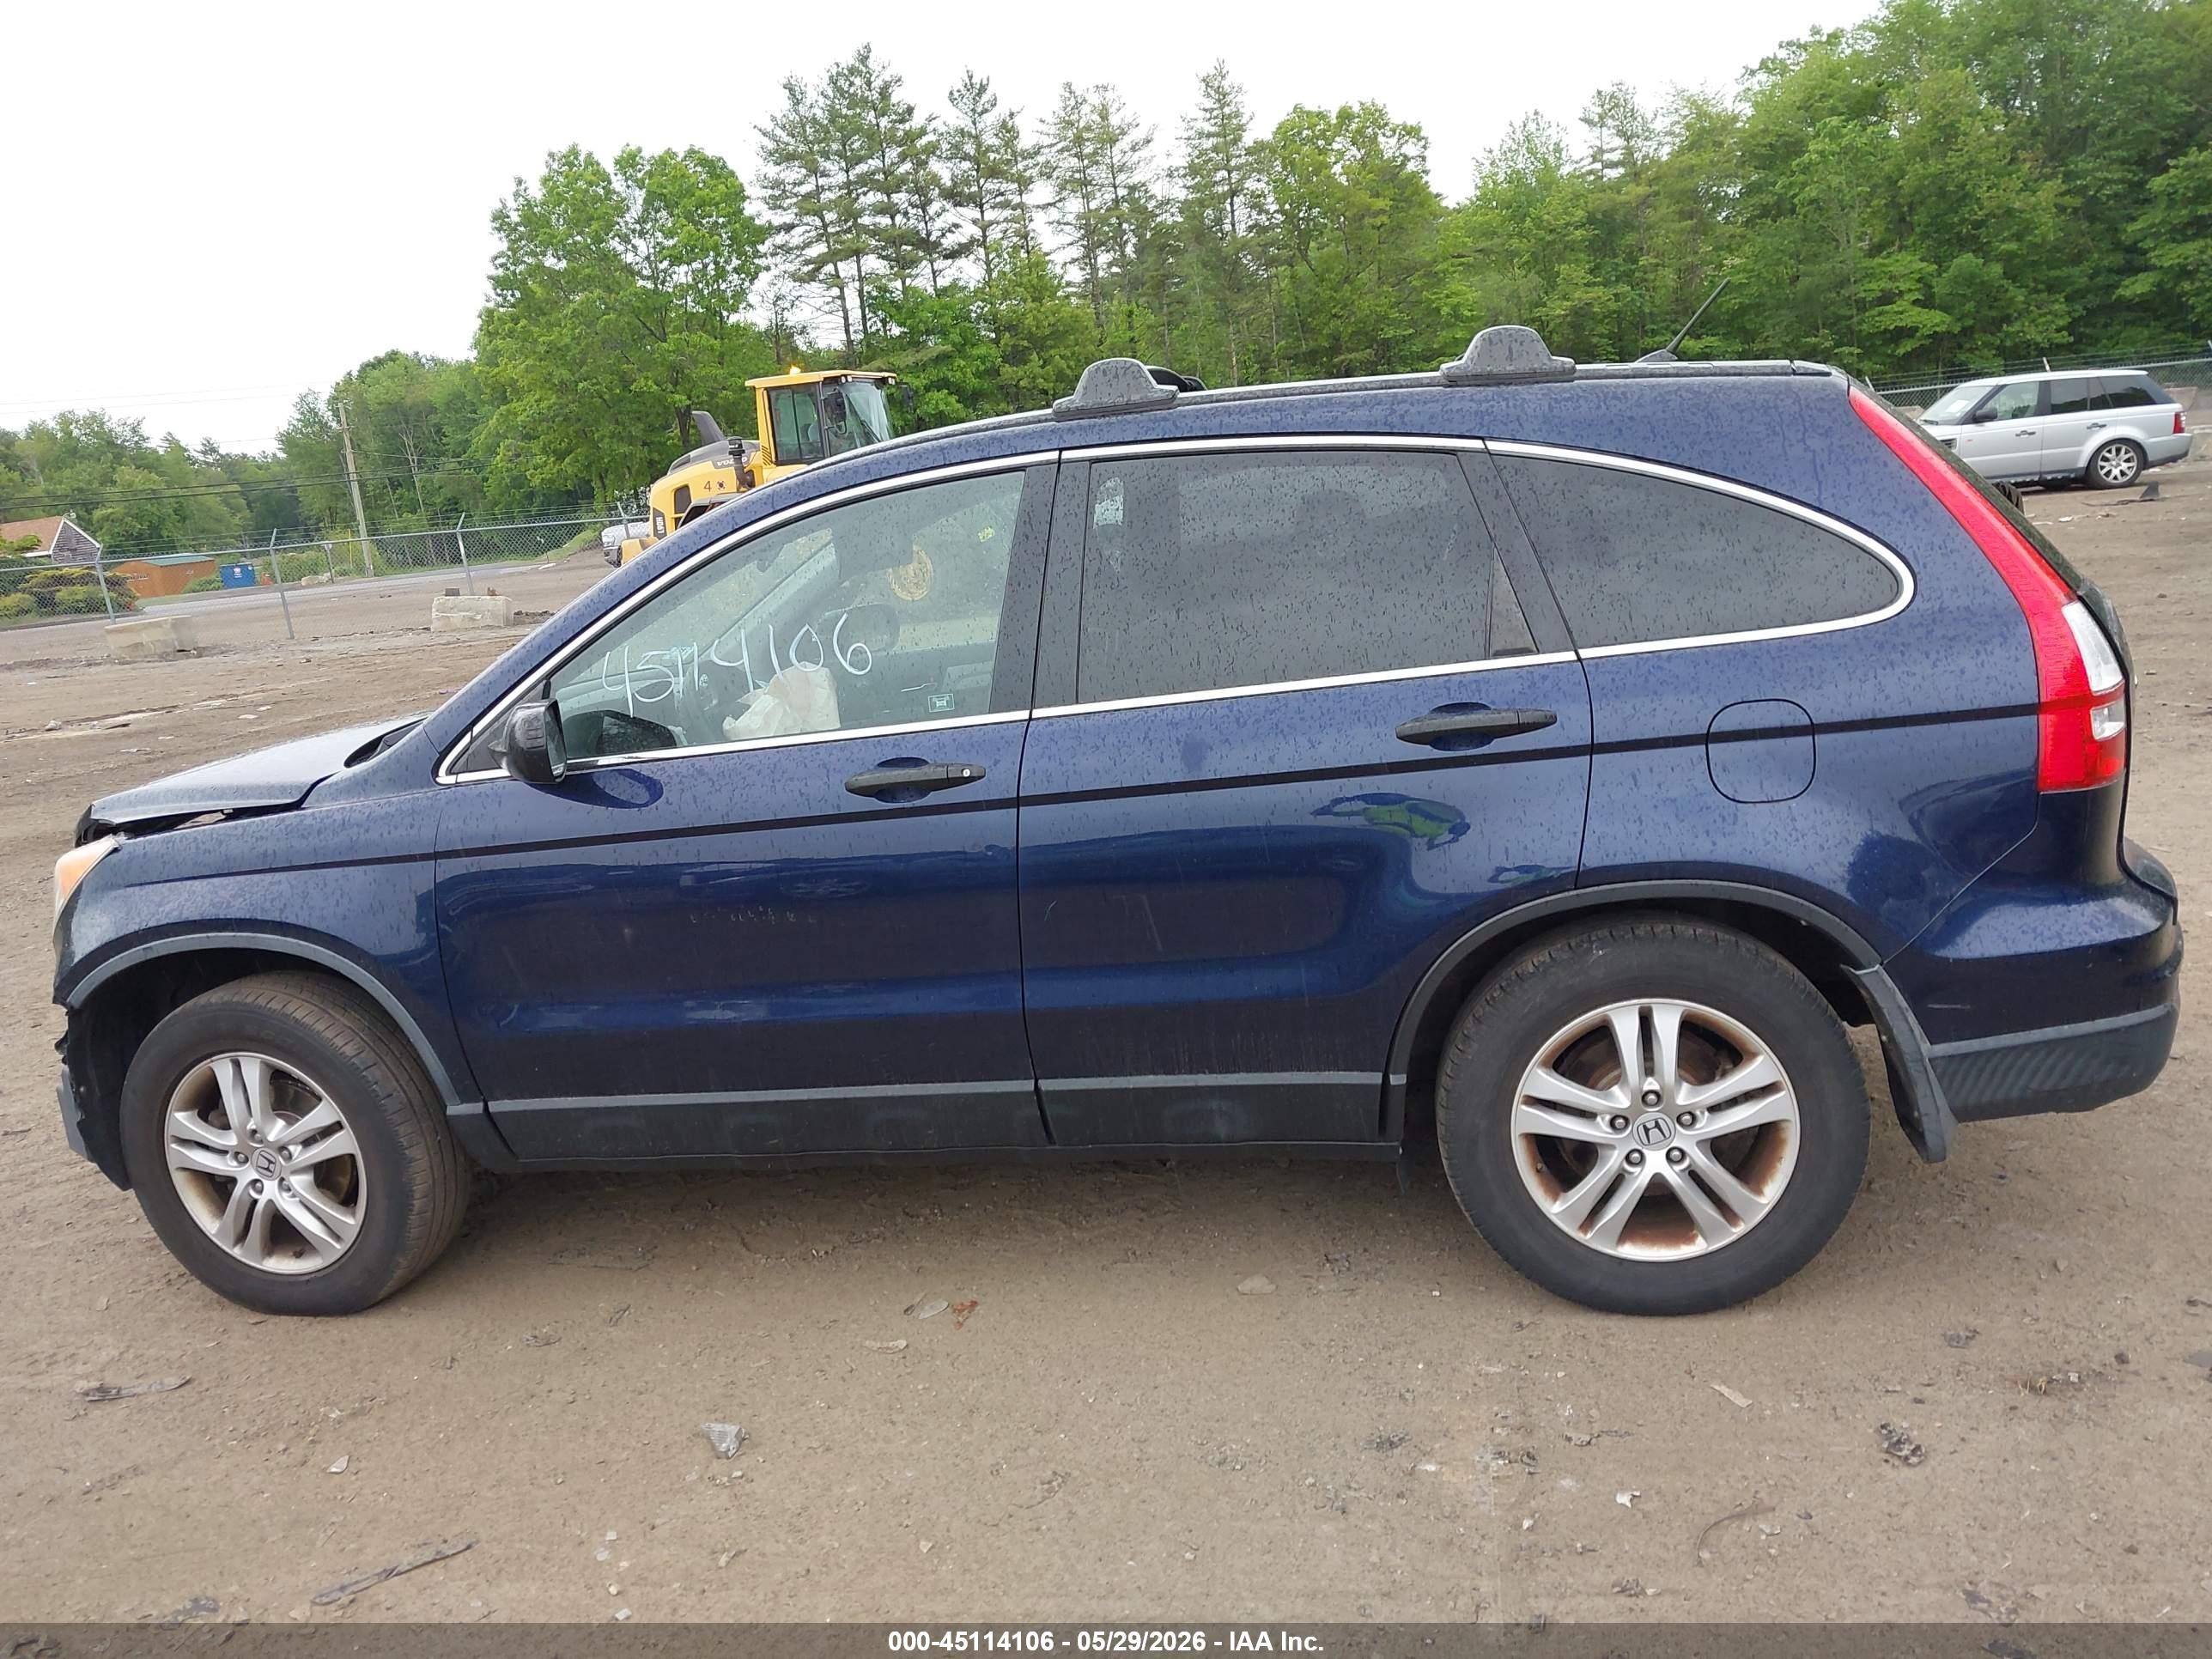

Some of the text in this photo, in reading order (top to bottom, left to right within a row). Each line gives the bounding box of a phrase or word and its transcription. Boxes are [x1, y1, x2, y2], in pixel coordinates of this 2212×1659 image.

[716, 456, 748, 466] VOLO
[703, 480, 712, 492] 4
[602, 612, 872, 718] 45114106
